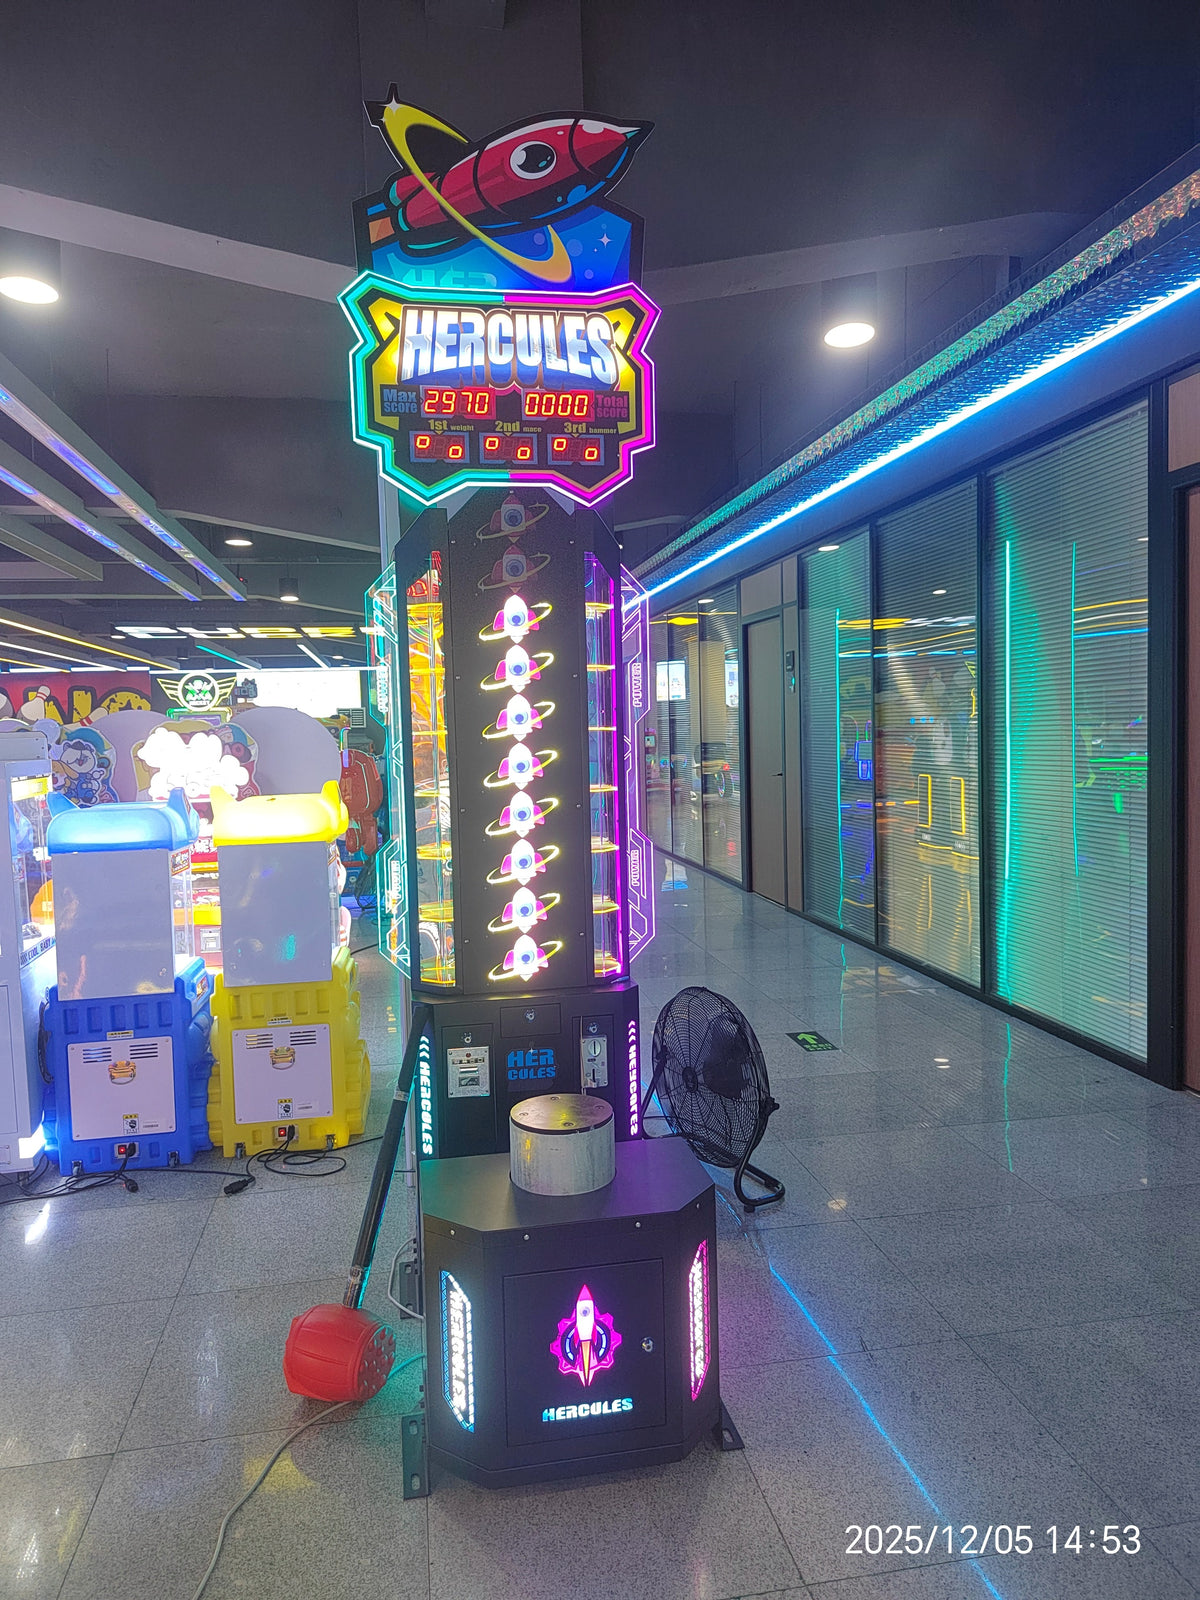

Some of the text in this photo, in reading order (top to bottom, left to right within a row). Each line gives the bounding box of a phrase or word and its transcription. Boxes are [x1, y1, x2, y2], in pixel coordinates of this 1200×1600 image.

[400, 306, 620, 387] HERCULES
[383, 389, 417, 402] Max
[424, 390, 489, 414] 2970
[596, 394, 628, 407] Total
[384, 401, 417, 413] score
[525, 393, 588, 416] 0000
[596, 407, 628, 418] score
[428, 419, 448, 431] 1st
[495, 420, 520, 432] 2nd
[564, 422, 586, 433] 3rd
[632, 662, 643, 708] POWER
[630, 849, 640, 887] POWER
[507, 1048, 554, 1067] HER
[507, 1066, 556, 1080] CULES
[542, 1397, 634, 1422] HERCULES
